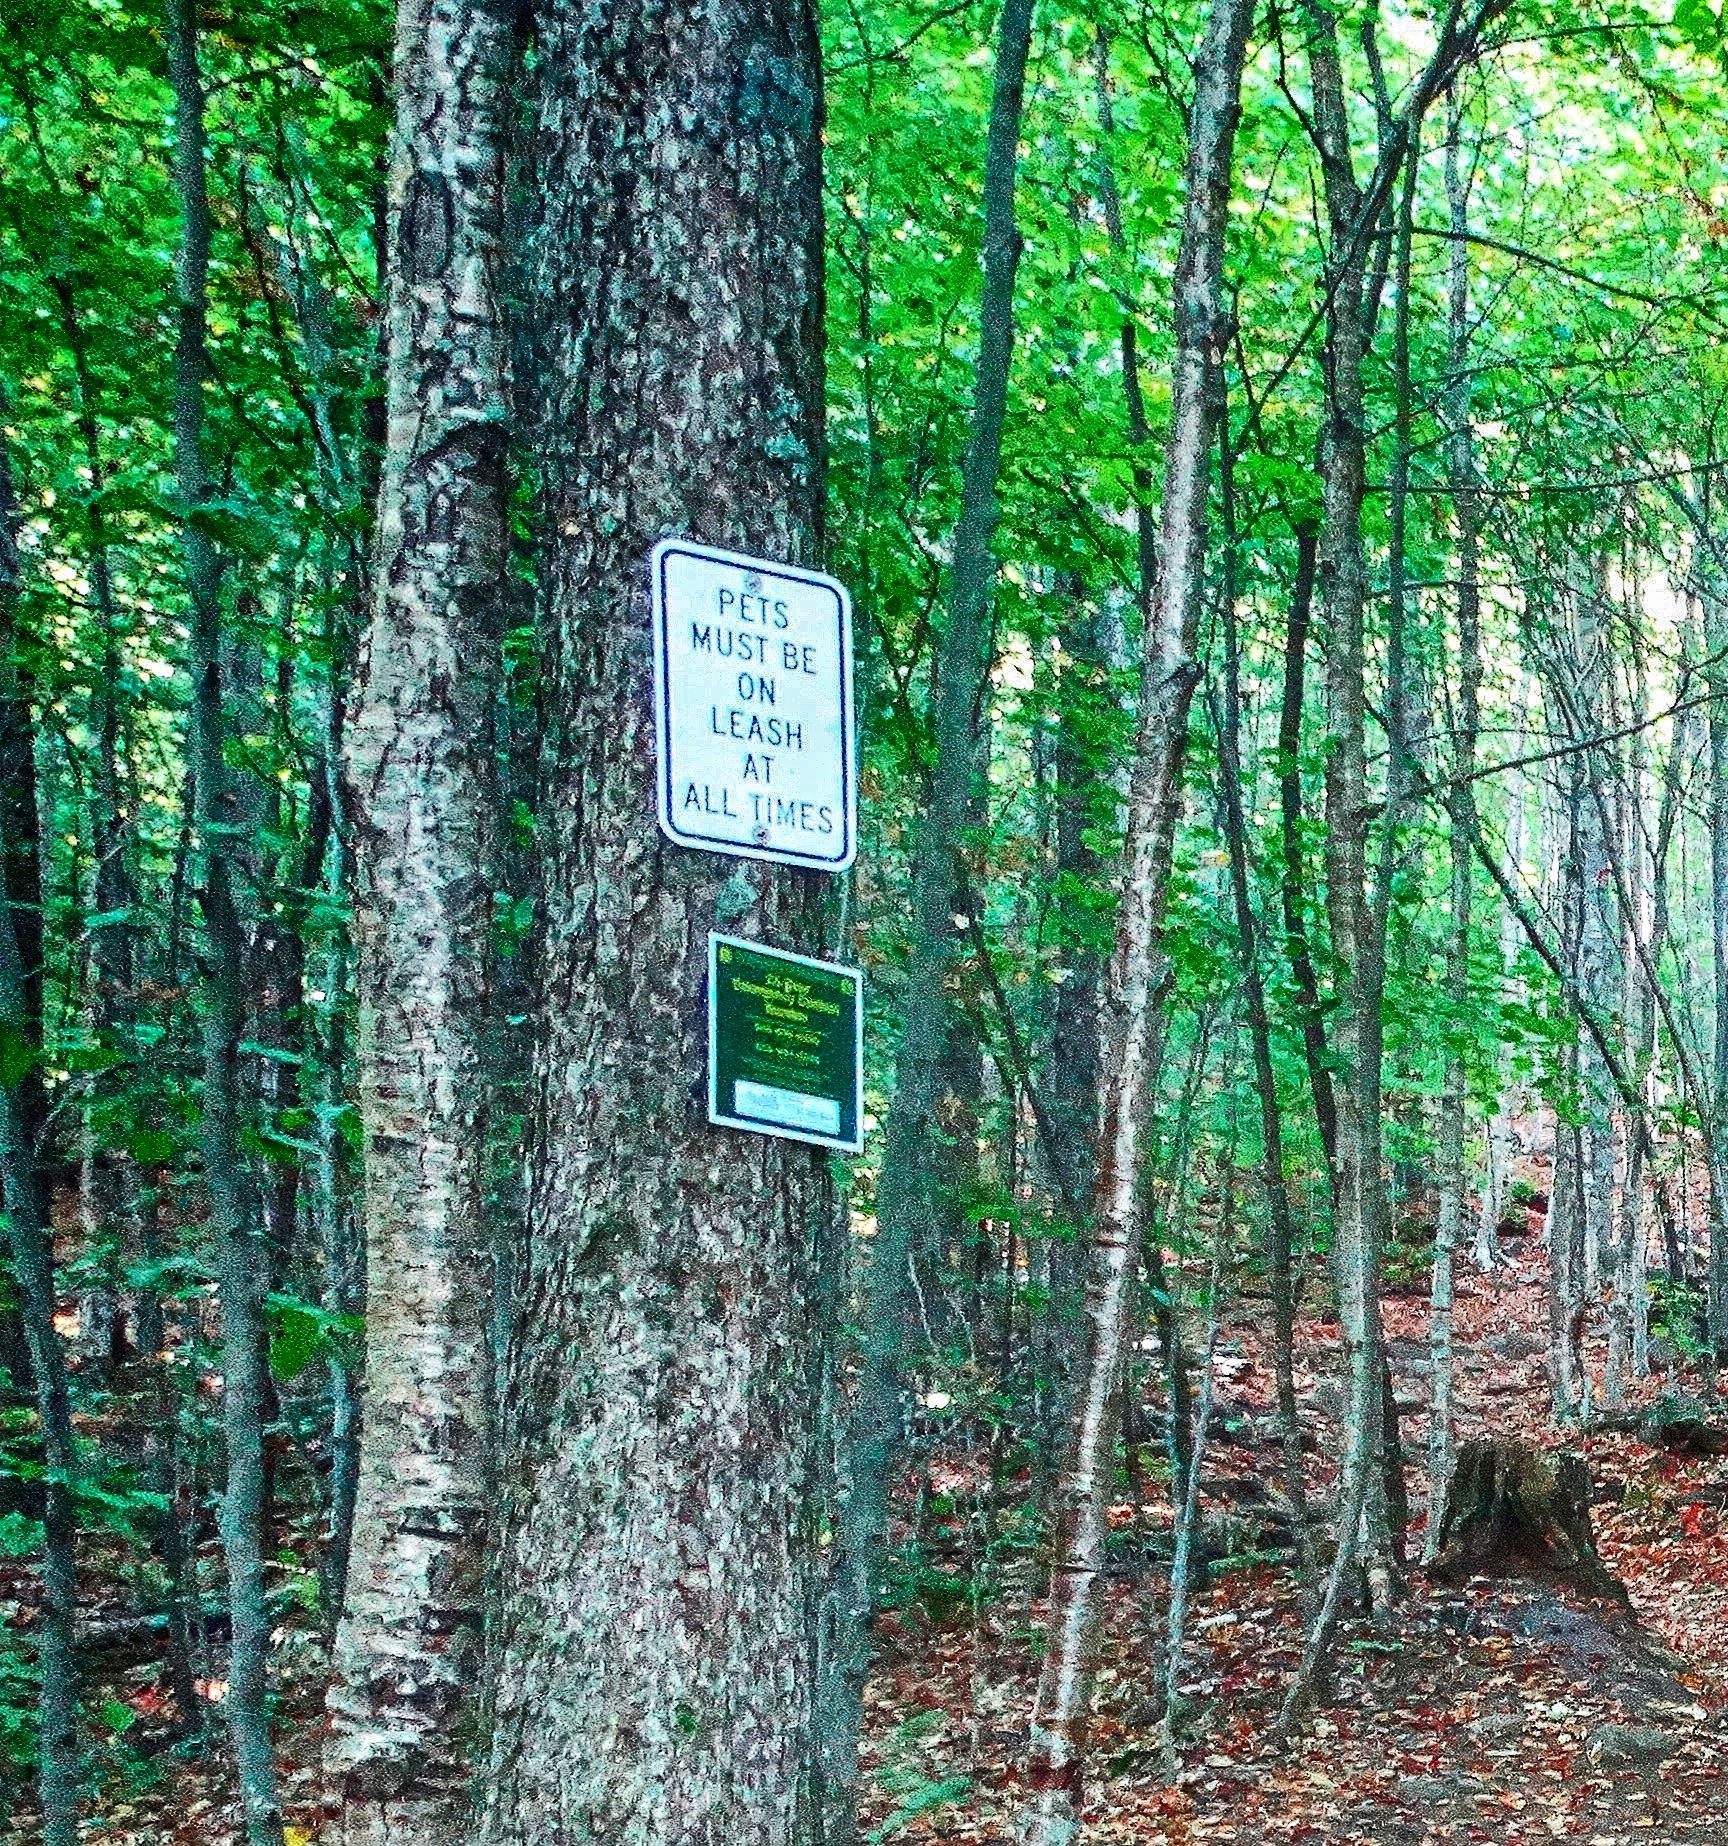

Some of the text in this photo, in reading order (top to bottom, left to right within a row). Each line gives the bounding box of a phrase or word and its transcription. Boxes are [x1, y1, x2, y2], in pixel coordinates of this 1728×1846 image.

[719, 588, 789, 629] PETS
[691, 621, 817, 675] MUST BE
[737, 671, 775, 706] ON
[711, 706, 802, 749] LEASH
[743, 752, 775, 783] AT
[684, 782, 832, 834] ALL TIMES
